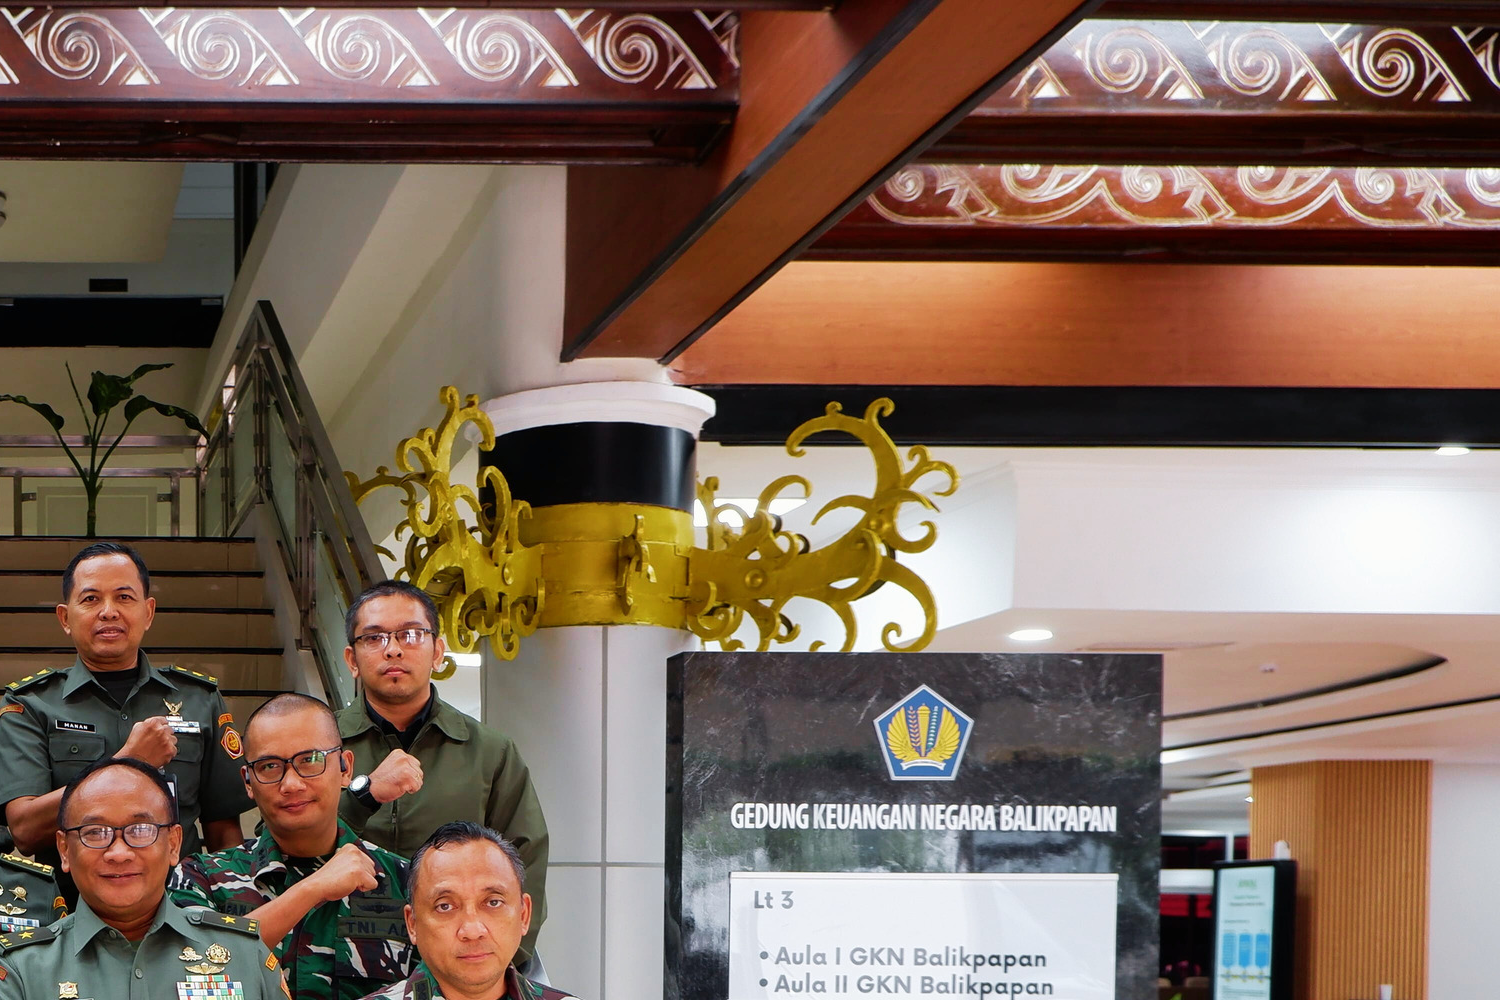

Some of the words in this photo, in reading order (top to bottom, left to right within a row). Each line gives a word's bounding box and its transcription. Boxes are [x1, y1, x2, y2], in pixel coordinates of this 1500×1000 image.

[64, 722, 88, 730] MANAN
[731, 802, 808, 829] GEDUNG
[813, 803, 916, 830] KEUANGAN
[921, 804, 995, 831] NEGARA
[1000, 805, 1117, 832] BALIKPAPAN
[753, 890, 774, 909] Lt
[781, 890, 794, 909] 3
[346, 920, 376, 934] TNI
[774, 946, 827, 966] Aula
[835, 947, 841, 966] I
[849, 947, 905, 966] GKN
[913, 946, 1047, 973] Balikpapan
[774, 974, 827, 994] Aula
[835, 975, 848, 994] II
[857, 975, 912, 994] GKN
[920, 974, 1054, 1000] Balikpapan
